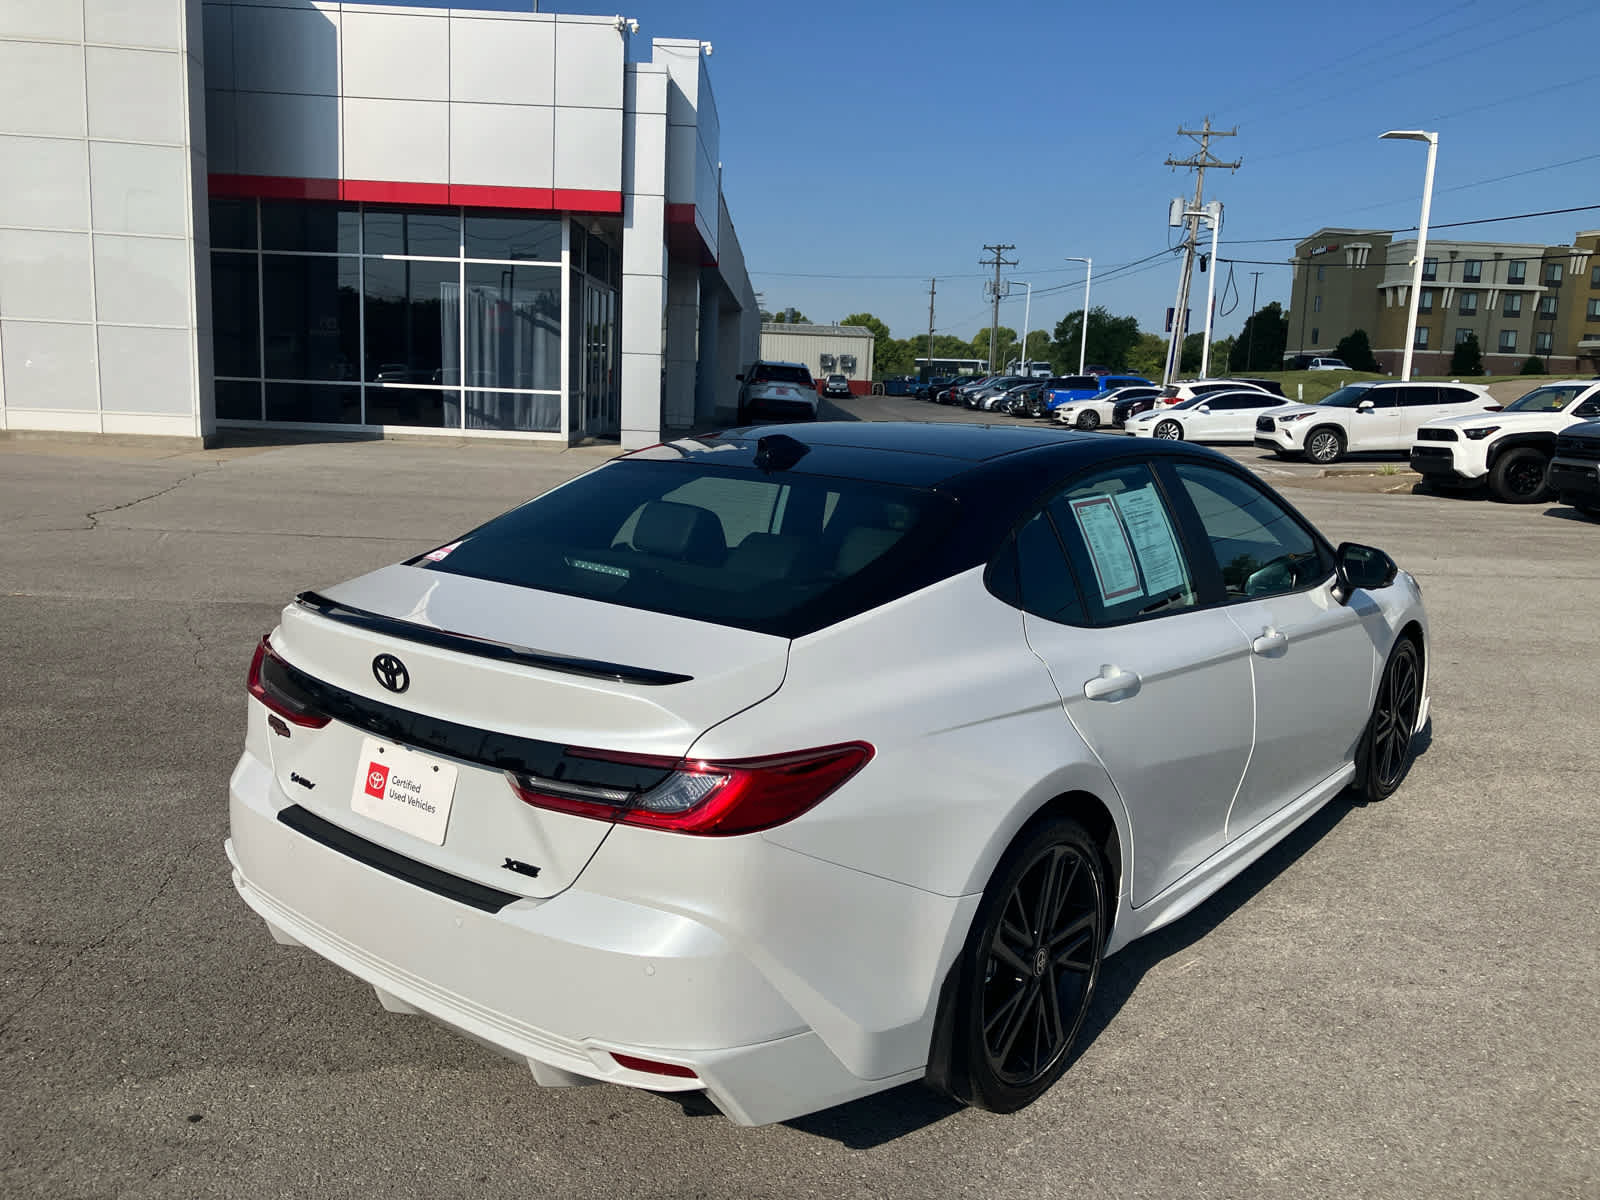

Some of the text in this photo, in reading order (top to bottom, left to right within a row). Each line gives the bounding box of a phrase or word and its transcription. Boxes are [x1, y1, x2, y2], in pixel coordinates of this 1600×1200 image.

[391, 776, 421, 793] Certified
[389, 788, 435, 813] Used Vehicles
